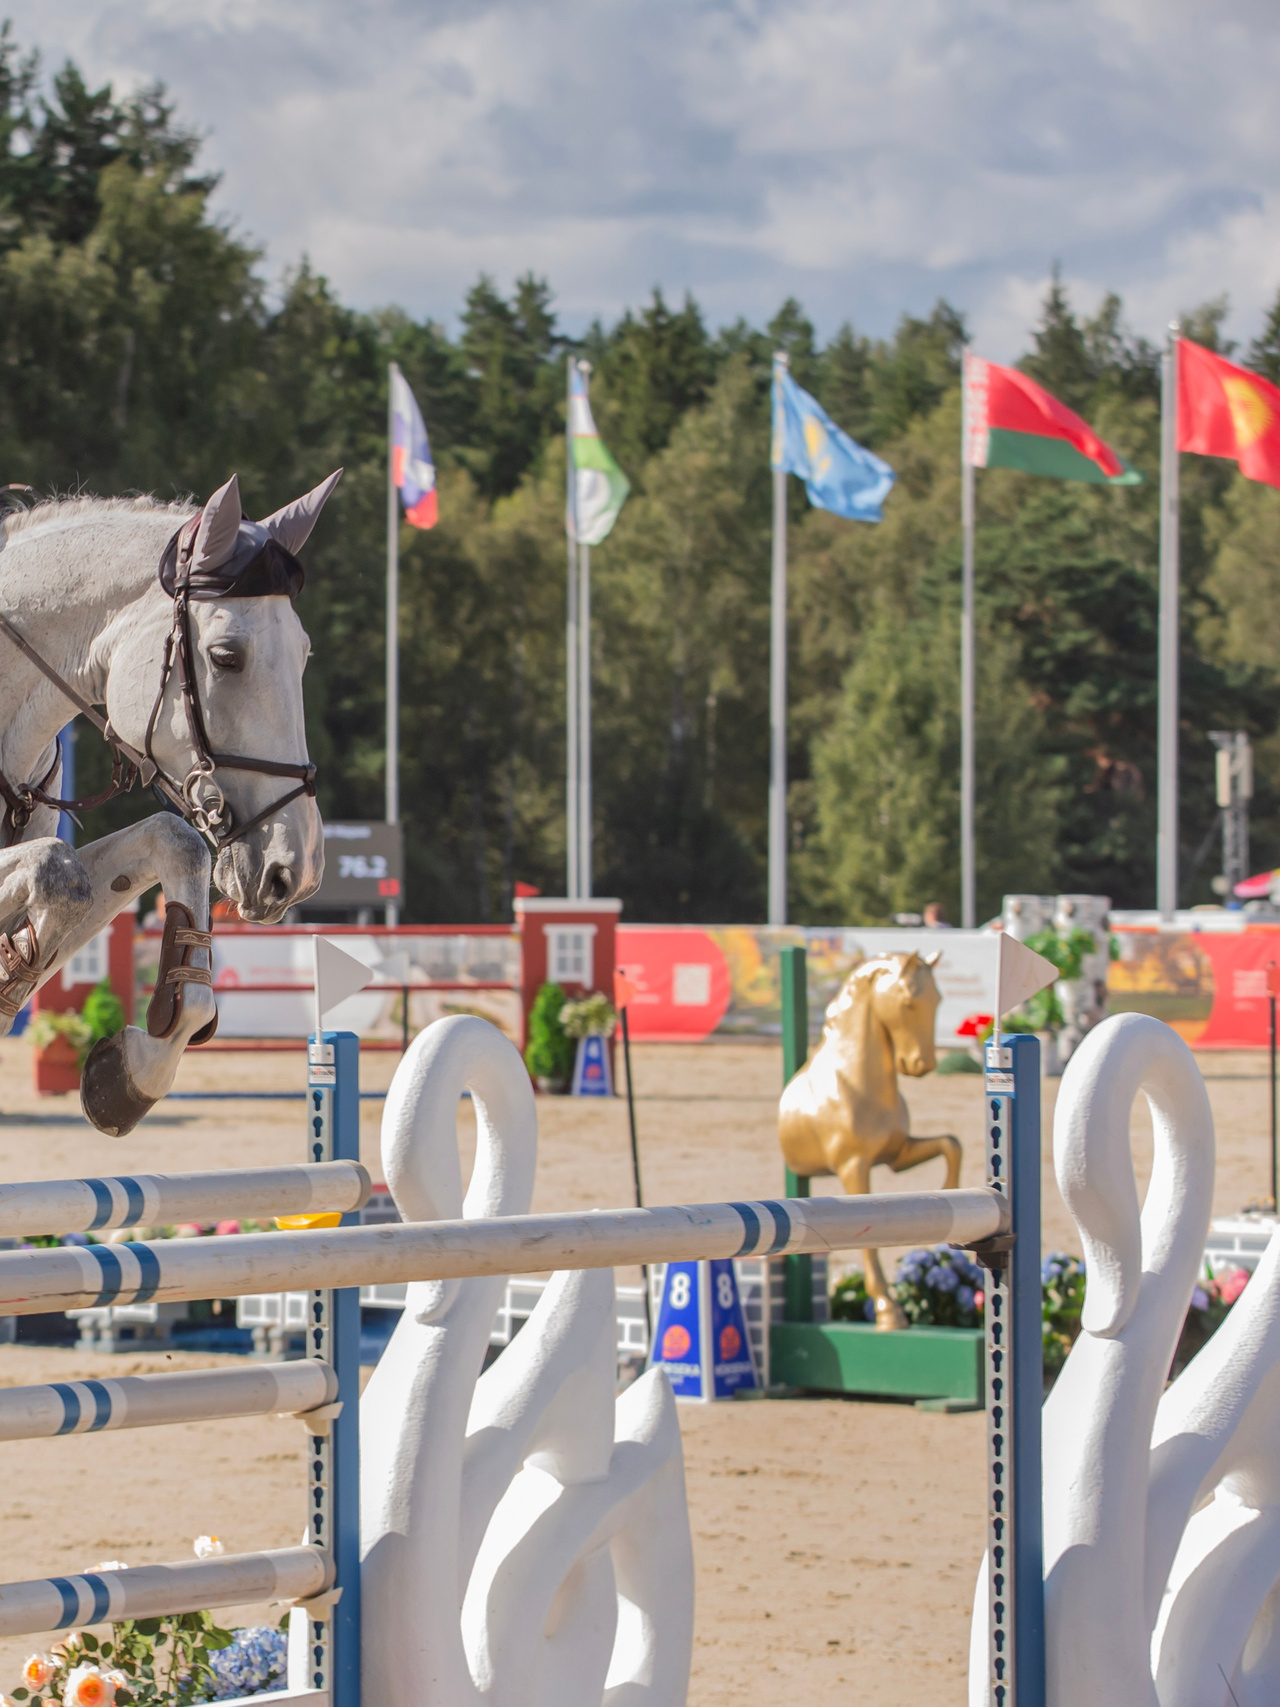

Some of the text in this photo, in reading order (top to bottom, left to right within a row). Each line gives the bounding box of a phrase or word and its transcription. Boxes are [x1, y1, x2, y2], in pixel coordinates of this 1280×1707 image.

[338, 855, 388, 878] 76.2
[670, 1272, 691, 1310] 8
[717, 1273, 734, 1310] 8
